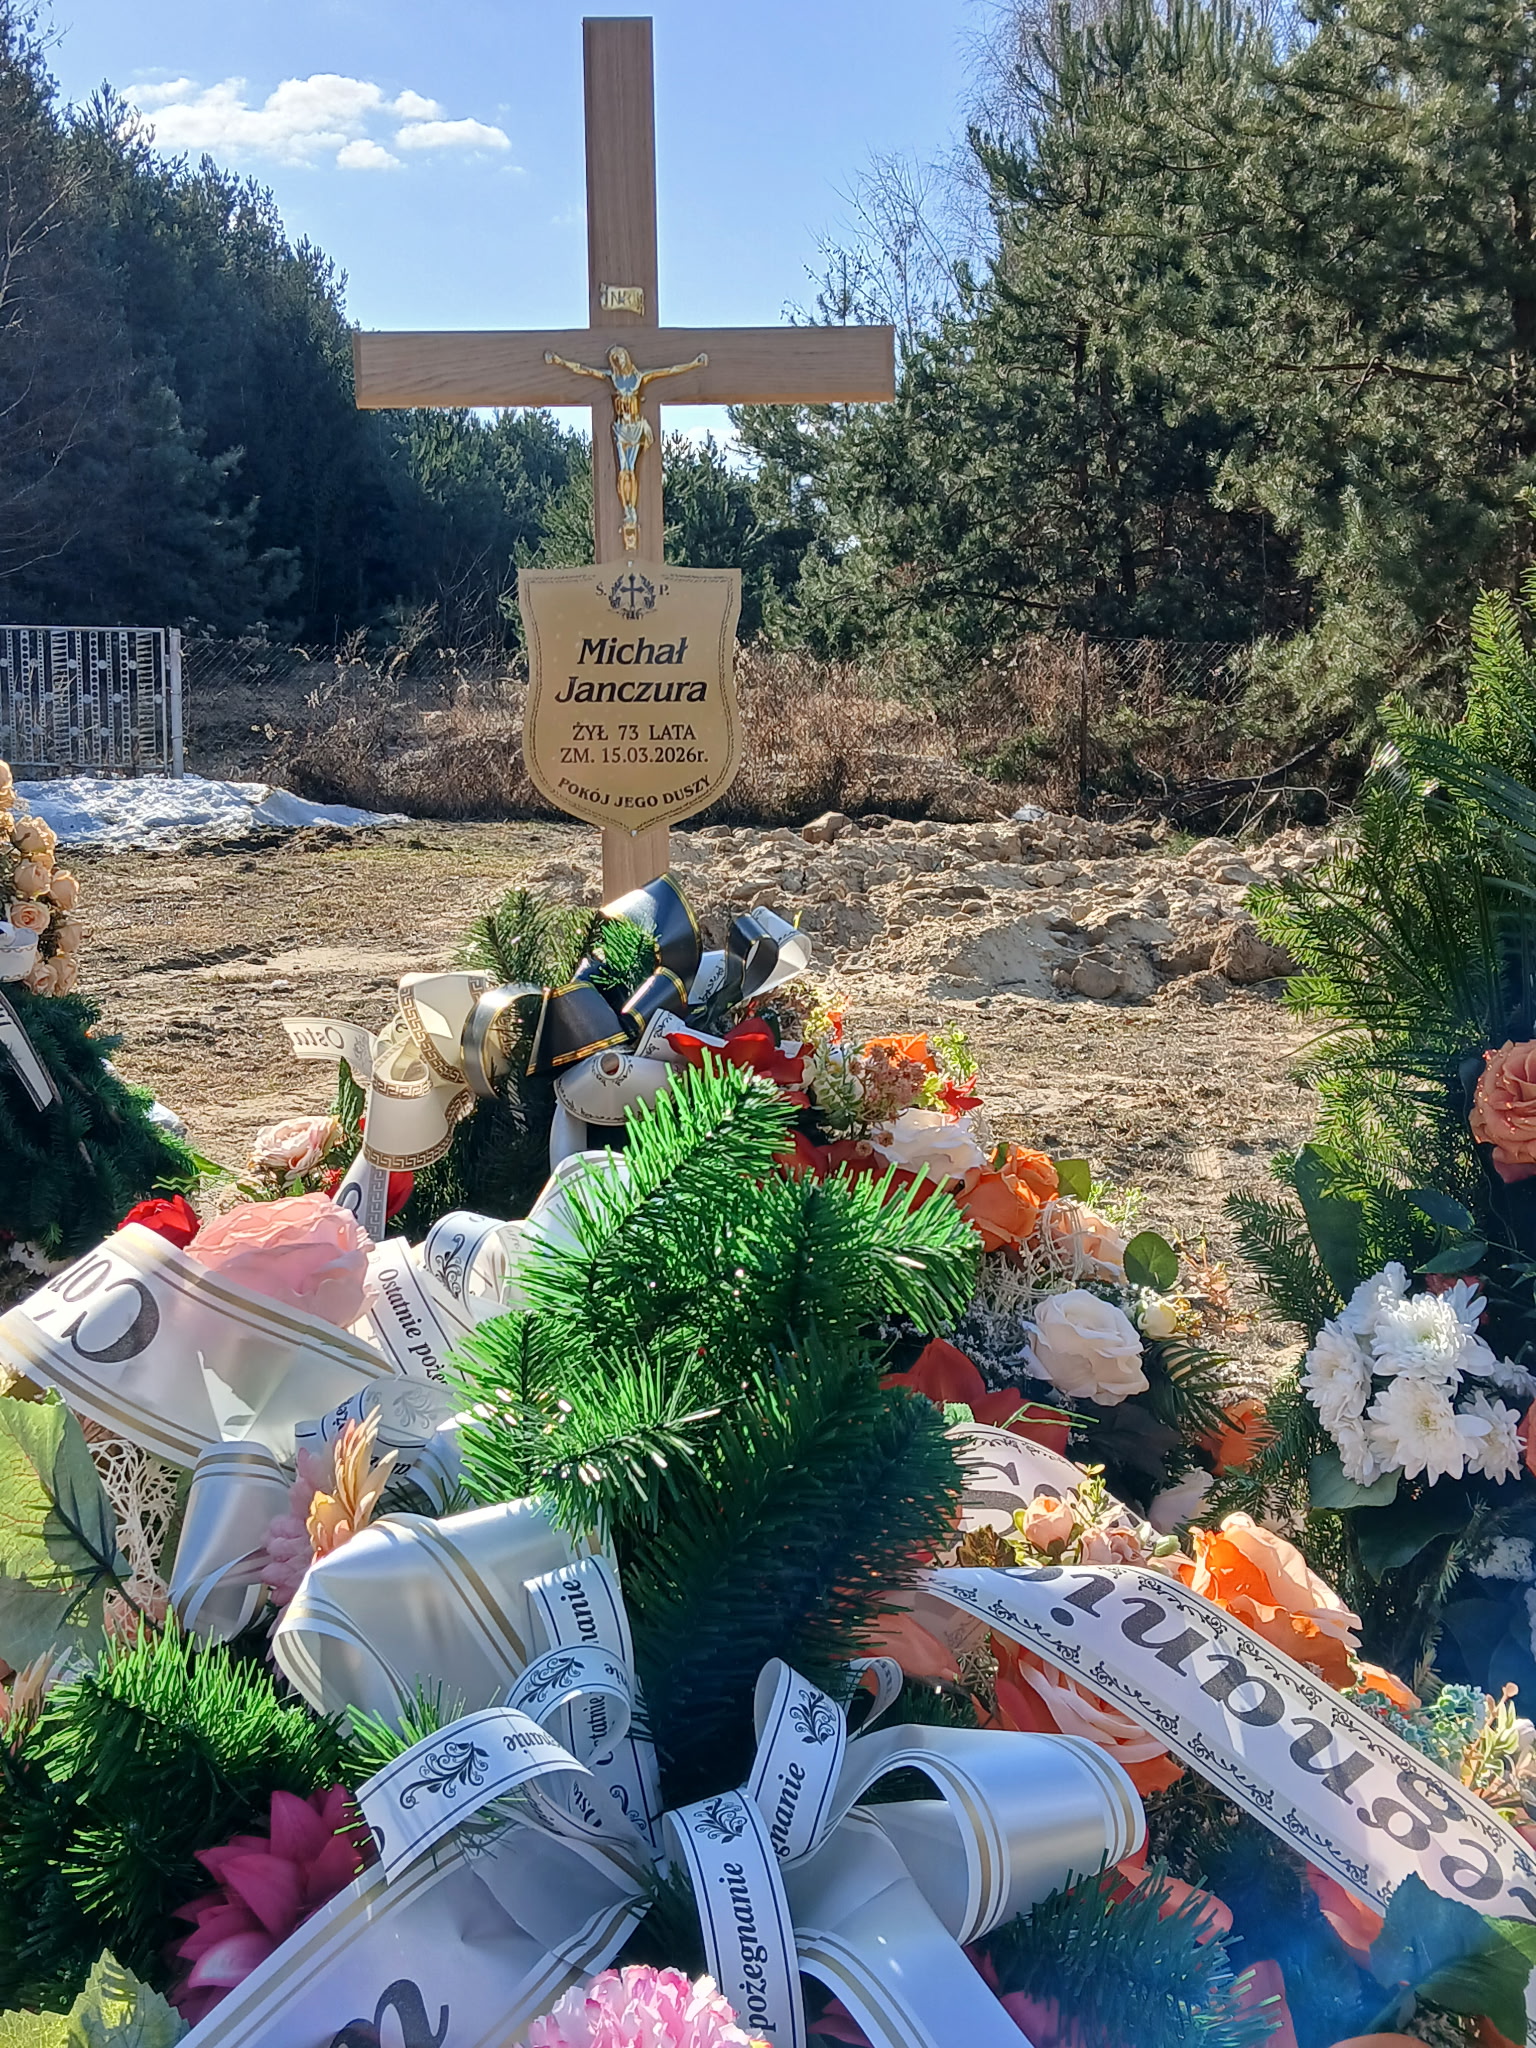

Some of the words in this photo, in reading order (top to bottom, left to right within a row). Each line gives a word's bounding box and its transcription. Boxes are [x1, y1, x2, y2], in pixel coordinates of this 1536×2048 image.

[577, 637, 689, 665] Michał
[554, 676, 708, 703] Janczura
[572, 721, 609, 741] ŻYŁ
[618, 724, 640, 741] 73
[649, 724, 697, 741] LATA
[560, 747, 595, 764] ZM.
[602, 747, 709, 764] 15.03.2026r.
[558, 776, 610, 806] POKÓJ
[614, 795, 658, 808] JEGO
[662, 774, 712, 805] DUSZY
[378, 1268, 423, 1339] Ostatnie
[718, 1862, 777, 2033] pożegnanie
